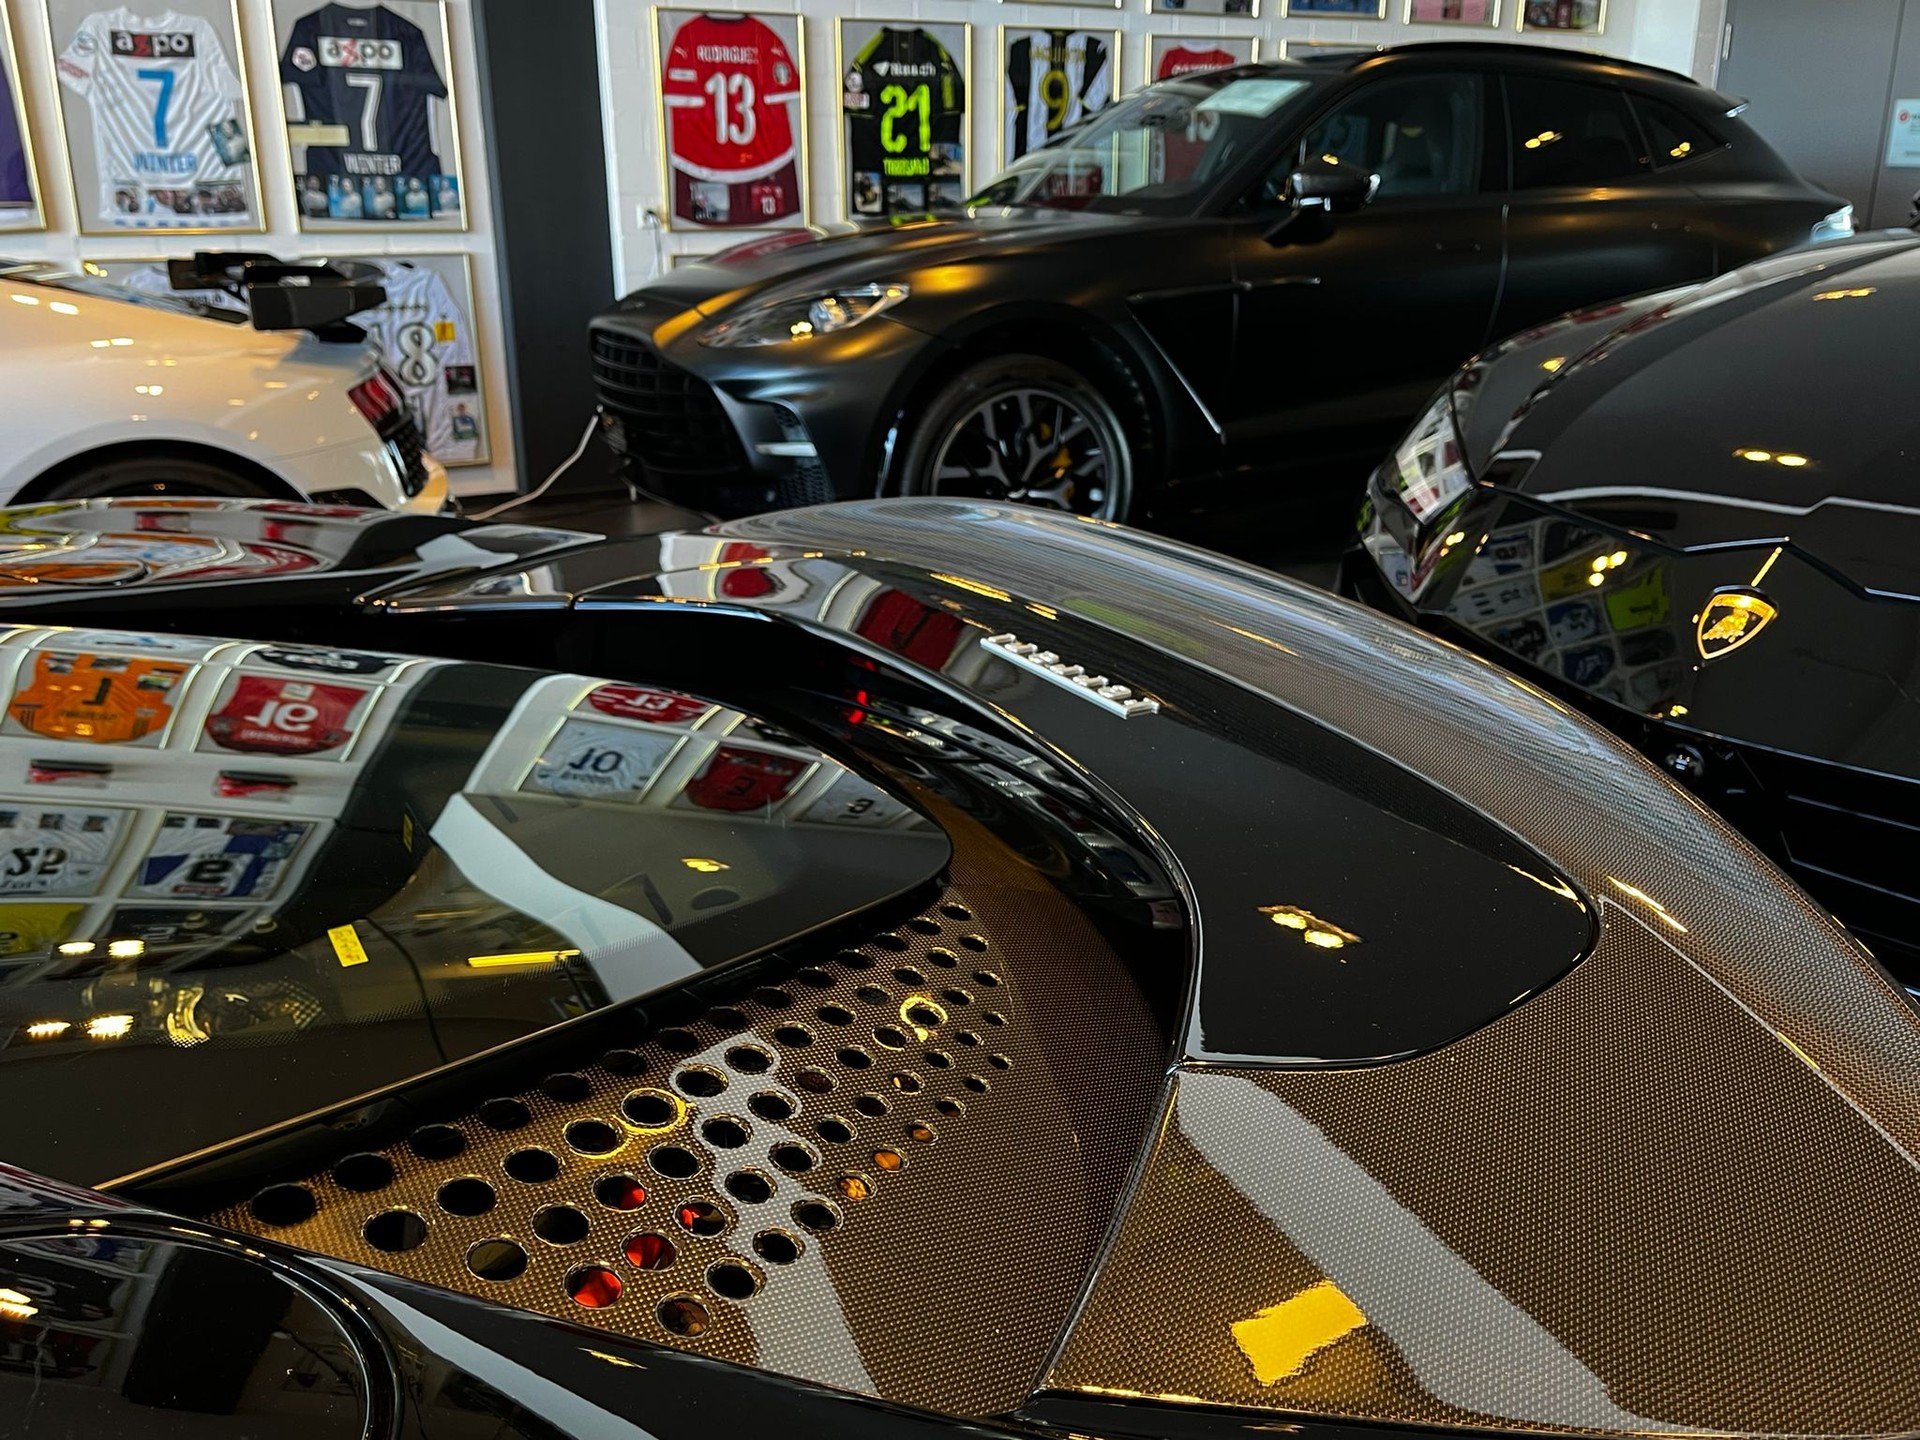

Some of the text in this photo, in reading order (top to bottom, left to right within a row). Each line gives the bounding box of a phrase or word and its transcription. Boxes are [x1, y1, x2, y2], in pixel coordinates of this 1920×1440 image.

[137, 69, 174, 149] 7
[345, 73, 383, 152] 7
[704, 71, 757, 146] 13
[880, 84, 931, 153] 21
[1040, 69, 1070, 131] 9
